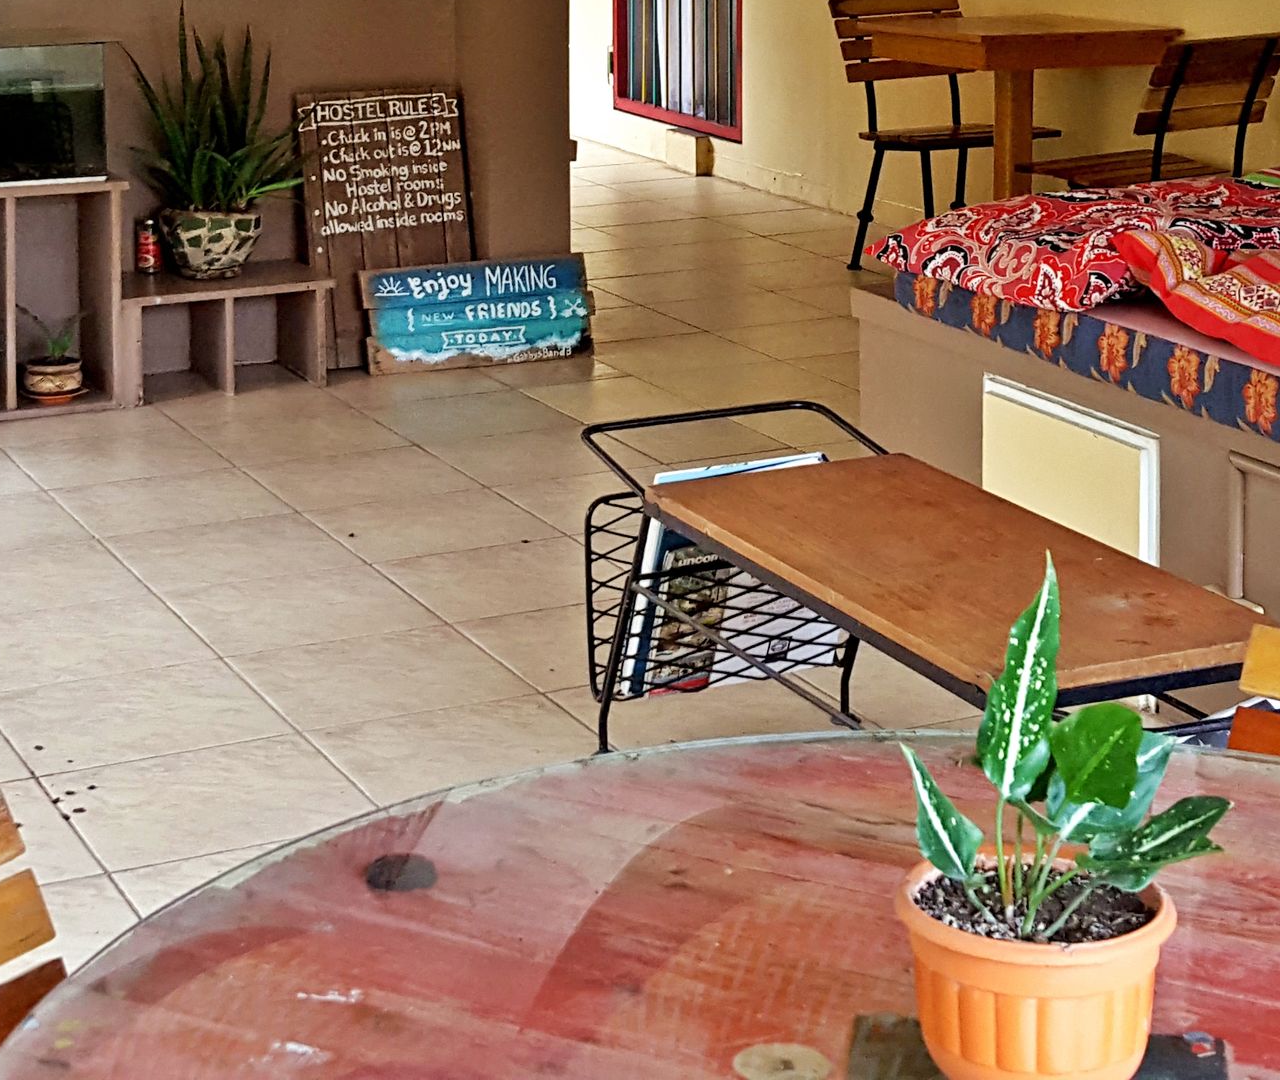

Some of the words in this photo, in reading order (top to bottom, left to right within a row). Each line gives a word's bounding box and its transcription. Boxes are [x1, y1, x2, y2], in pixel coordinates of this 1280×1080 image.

[317, 102, 385, 122] HOSTEL
[388, 97, 442, 116] RULES
[373, 128, 387, 142] in
[373, 148, 398, 160] out
[350, 163, 409, 181] Smoking
[346, 178, 392, 198] Hostel
[351, 195, 402, 216] Alcohol
[404, 194, 415, 208] &
[417, 191, 462, 210] Drugs
[320, 215, 375, 237] allowed
[376, 212, 418, 229] inside
[420, 209, 465, 224] rooms
[408, 271, 472, 301] Enjoy
[484, 264, 557, 296] MAKING
[421, 311, 455, 322] NEW
[465, 299, 542, 321] FRIENDS
[453, 330, 513, 345] TODAY
